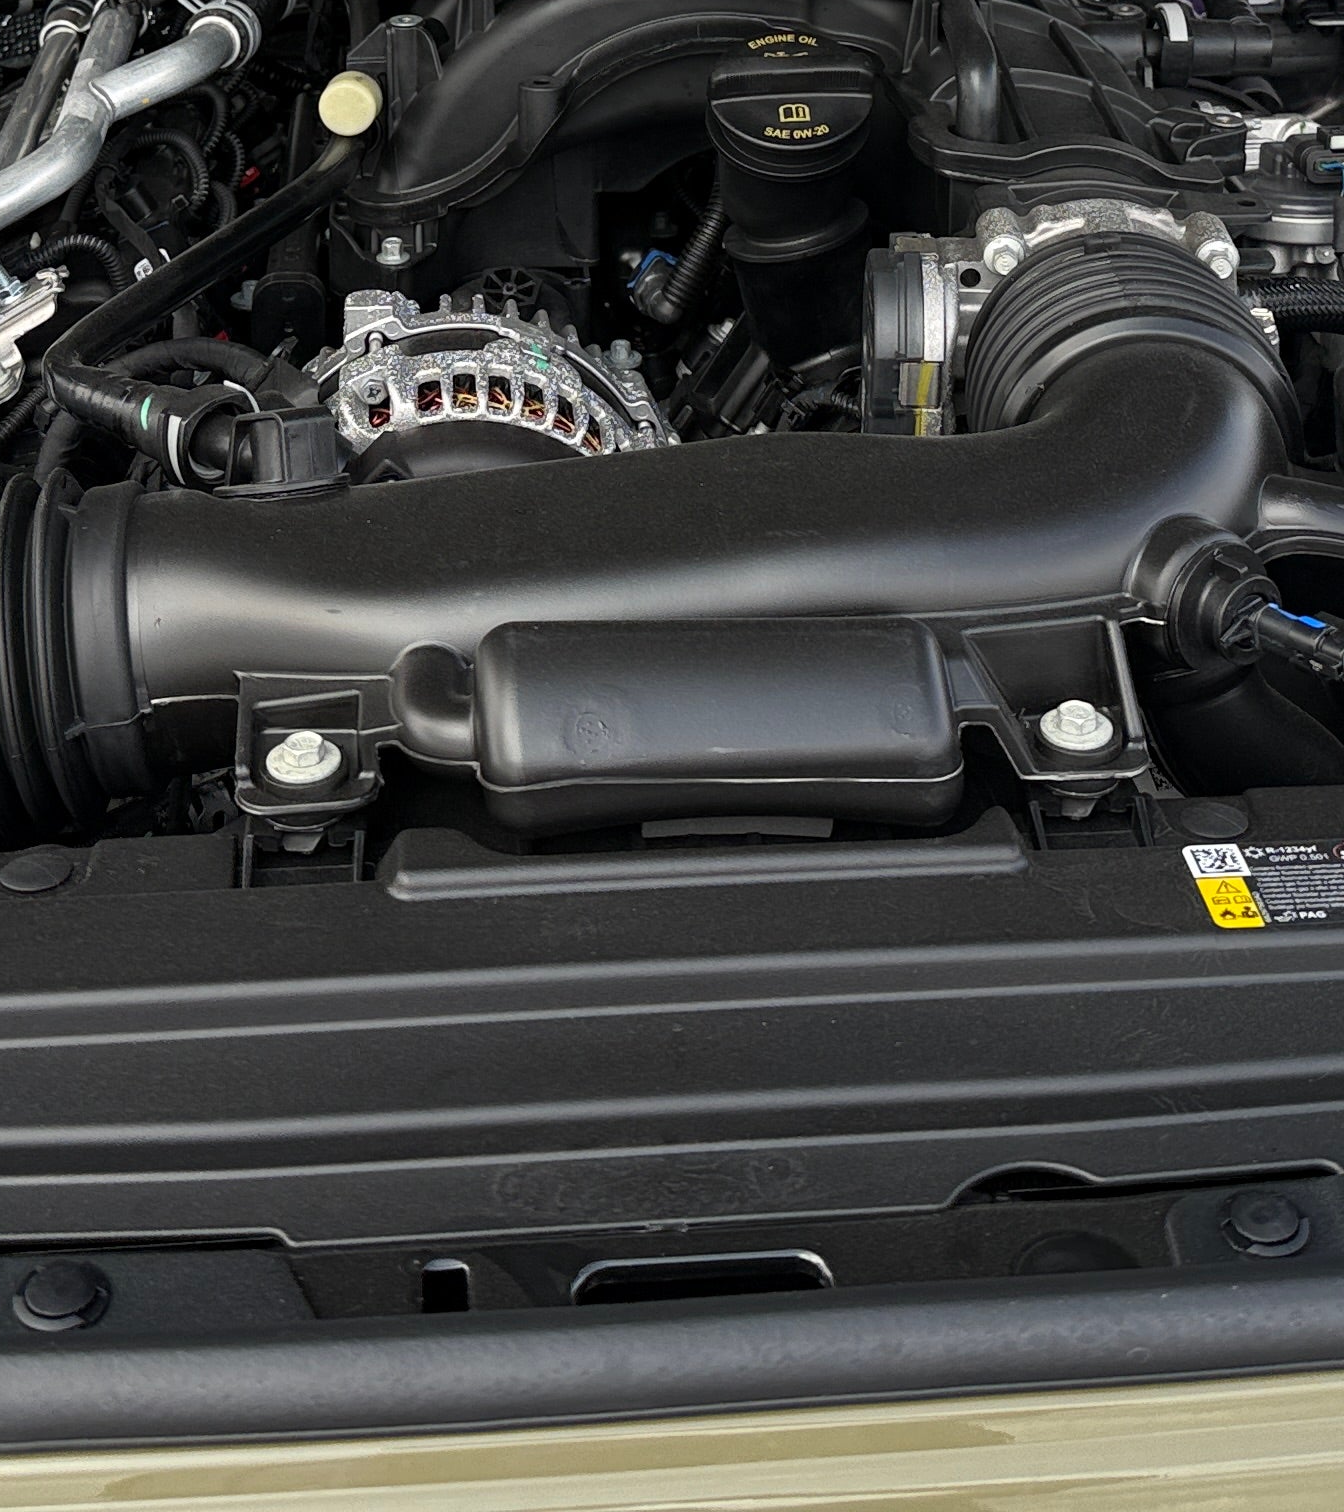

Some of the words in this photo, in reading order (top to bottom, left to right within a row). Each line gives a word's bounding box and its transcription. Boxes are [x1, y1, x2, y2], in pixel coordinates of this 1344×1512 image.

[747, 34, 796, 50] ENGINE
[798, 35, 819, 47] OIL
[763, 126, 791, 139] SAE
[792, 124, 830, 139] 0W-20
[1264, 844, 1318, 854] R-1234yf
[1268, 853, 1298, 863] GWP
[1298, 910, 1327, 919] PAG
